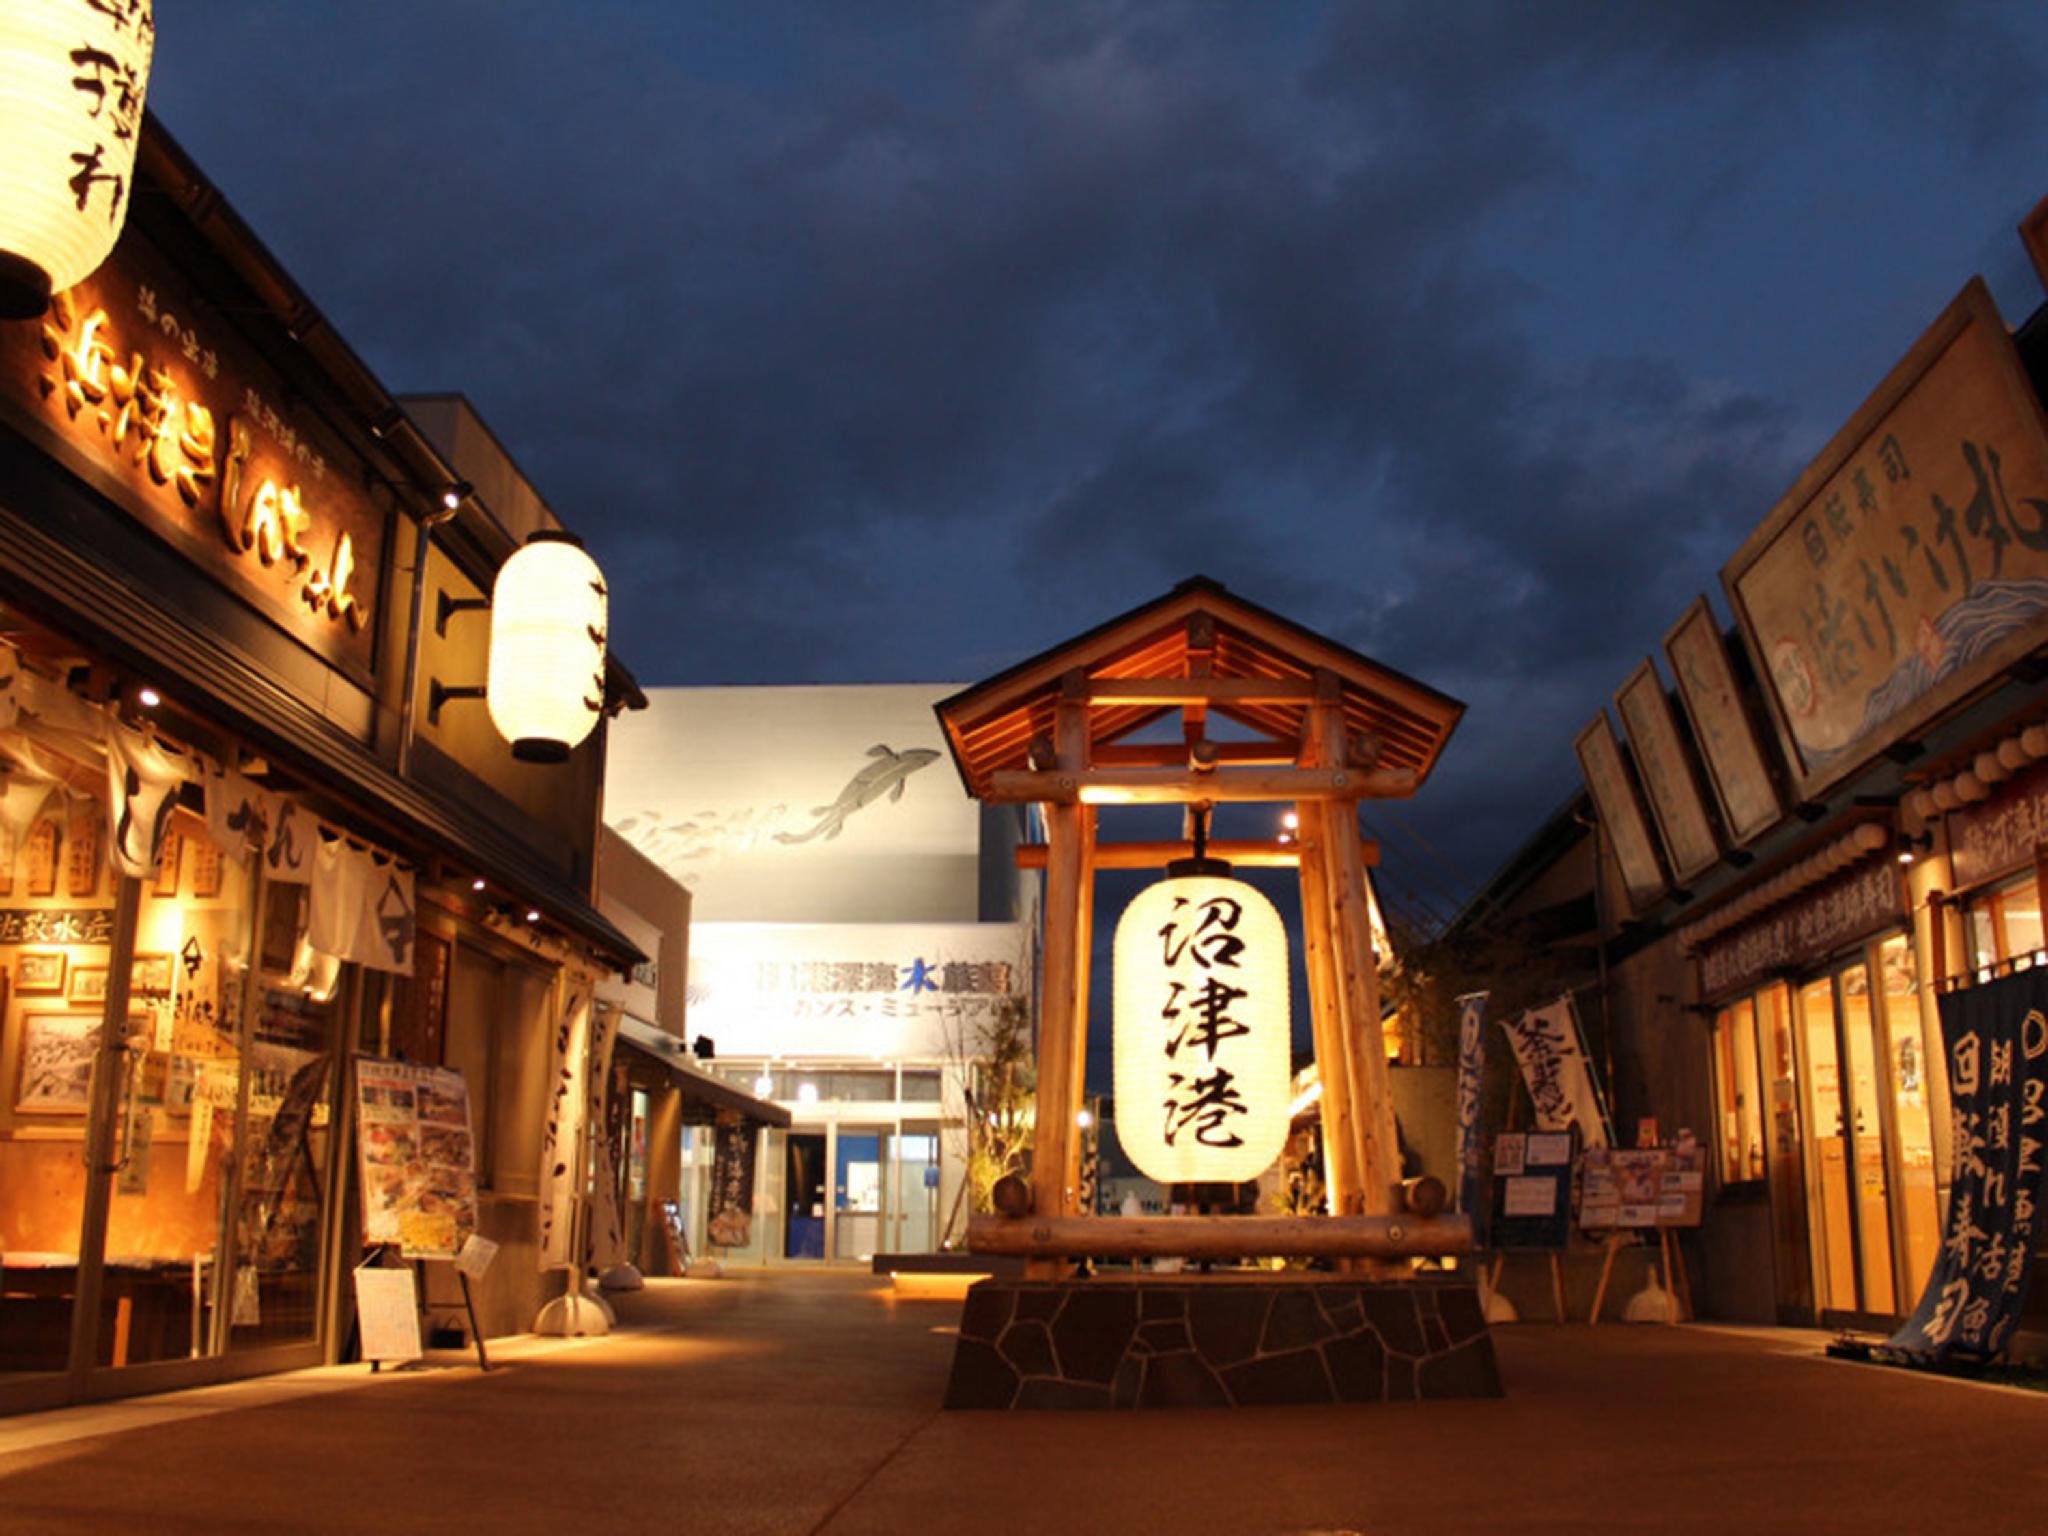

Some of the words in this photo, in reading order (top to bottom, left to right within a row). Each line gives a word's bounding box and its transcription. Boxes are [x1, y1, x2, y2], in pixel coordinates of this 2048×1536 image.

[1801, 432, 1912, 571] 回転寿司
[1157, 896, 1251, 1149] 沼津港
[1923, 1030, 1987, 1346] 回転寿司
